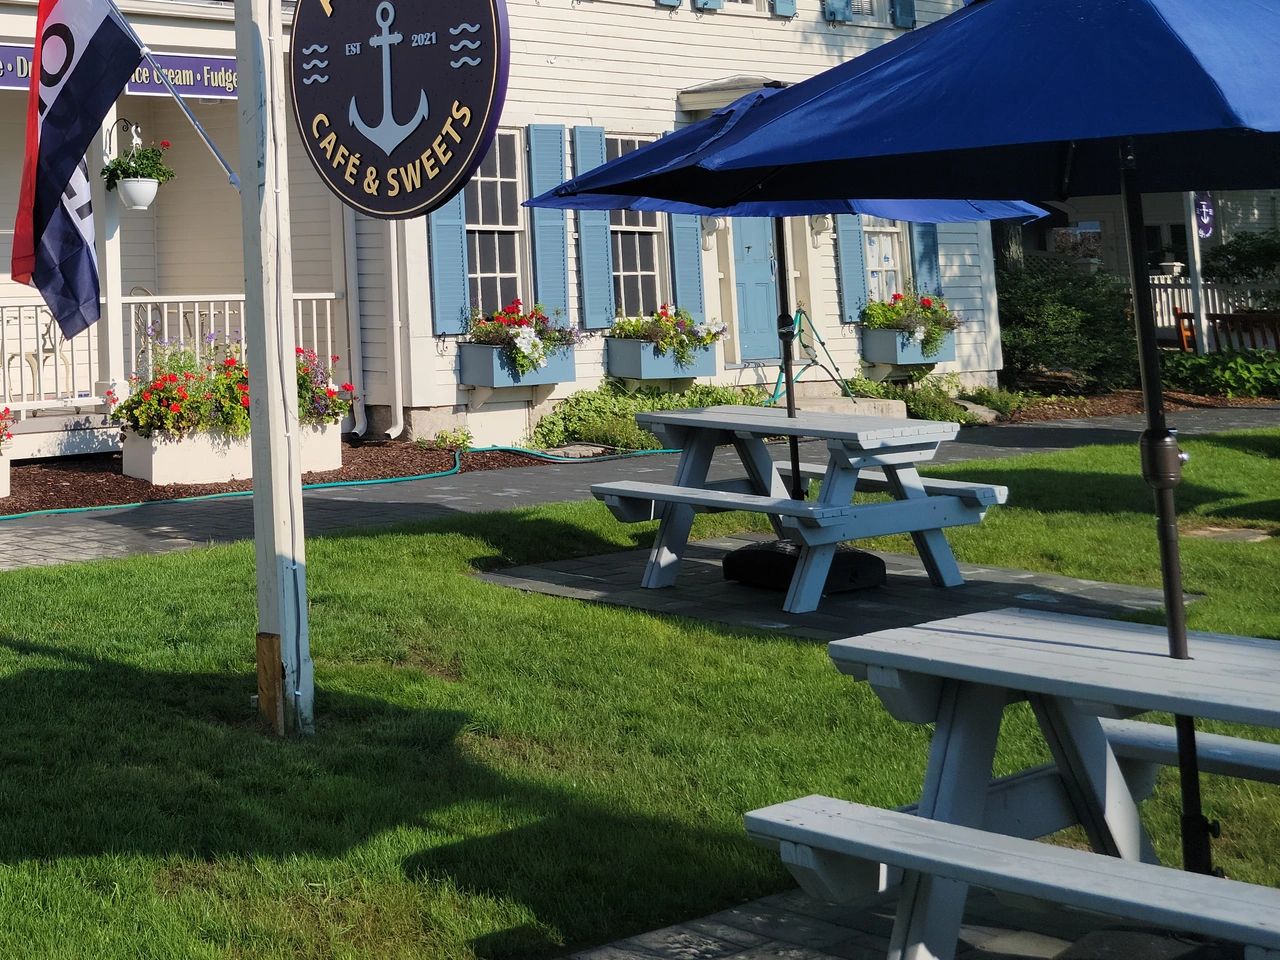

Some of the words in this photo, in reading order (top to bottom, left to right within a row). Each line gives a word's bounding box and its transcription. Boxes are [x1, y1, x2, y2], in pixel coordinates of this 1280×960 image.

[345, 42, 362, 56] EST
[411, 32, 437, 47] 2021
[311, 113, 361, 186] CAFÉ
[363, 166, 380, 196] &
[386, 100, 472, 197] SWEETS
